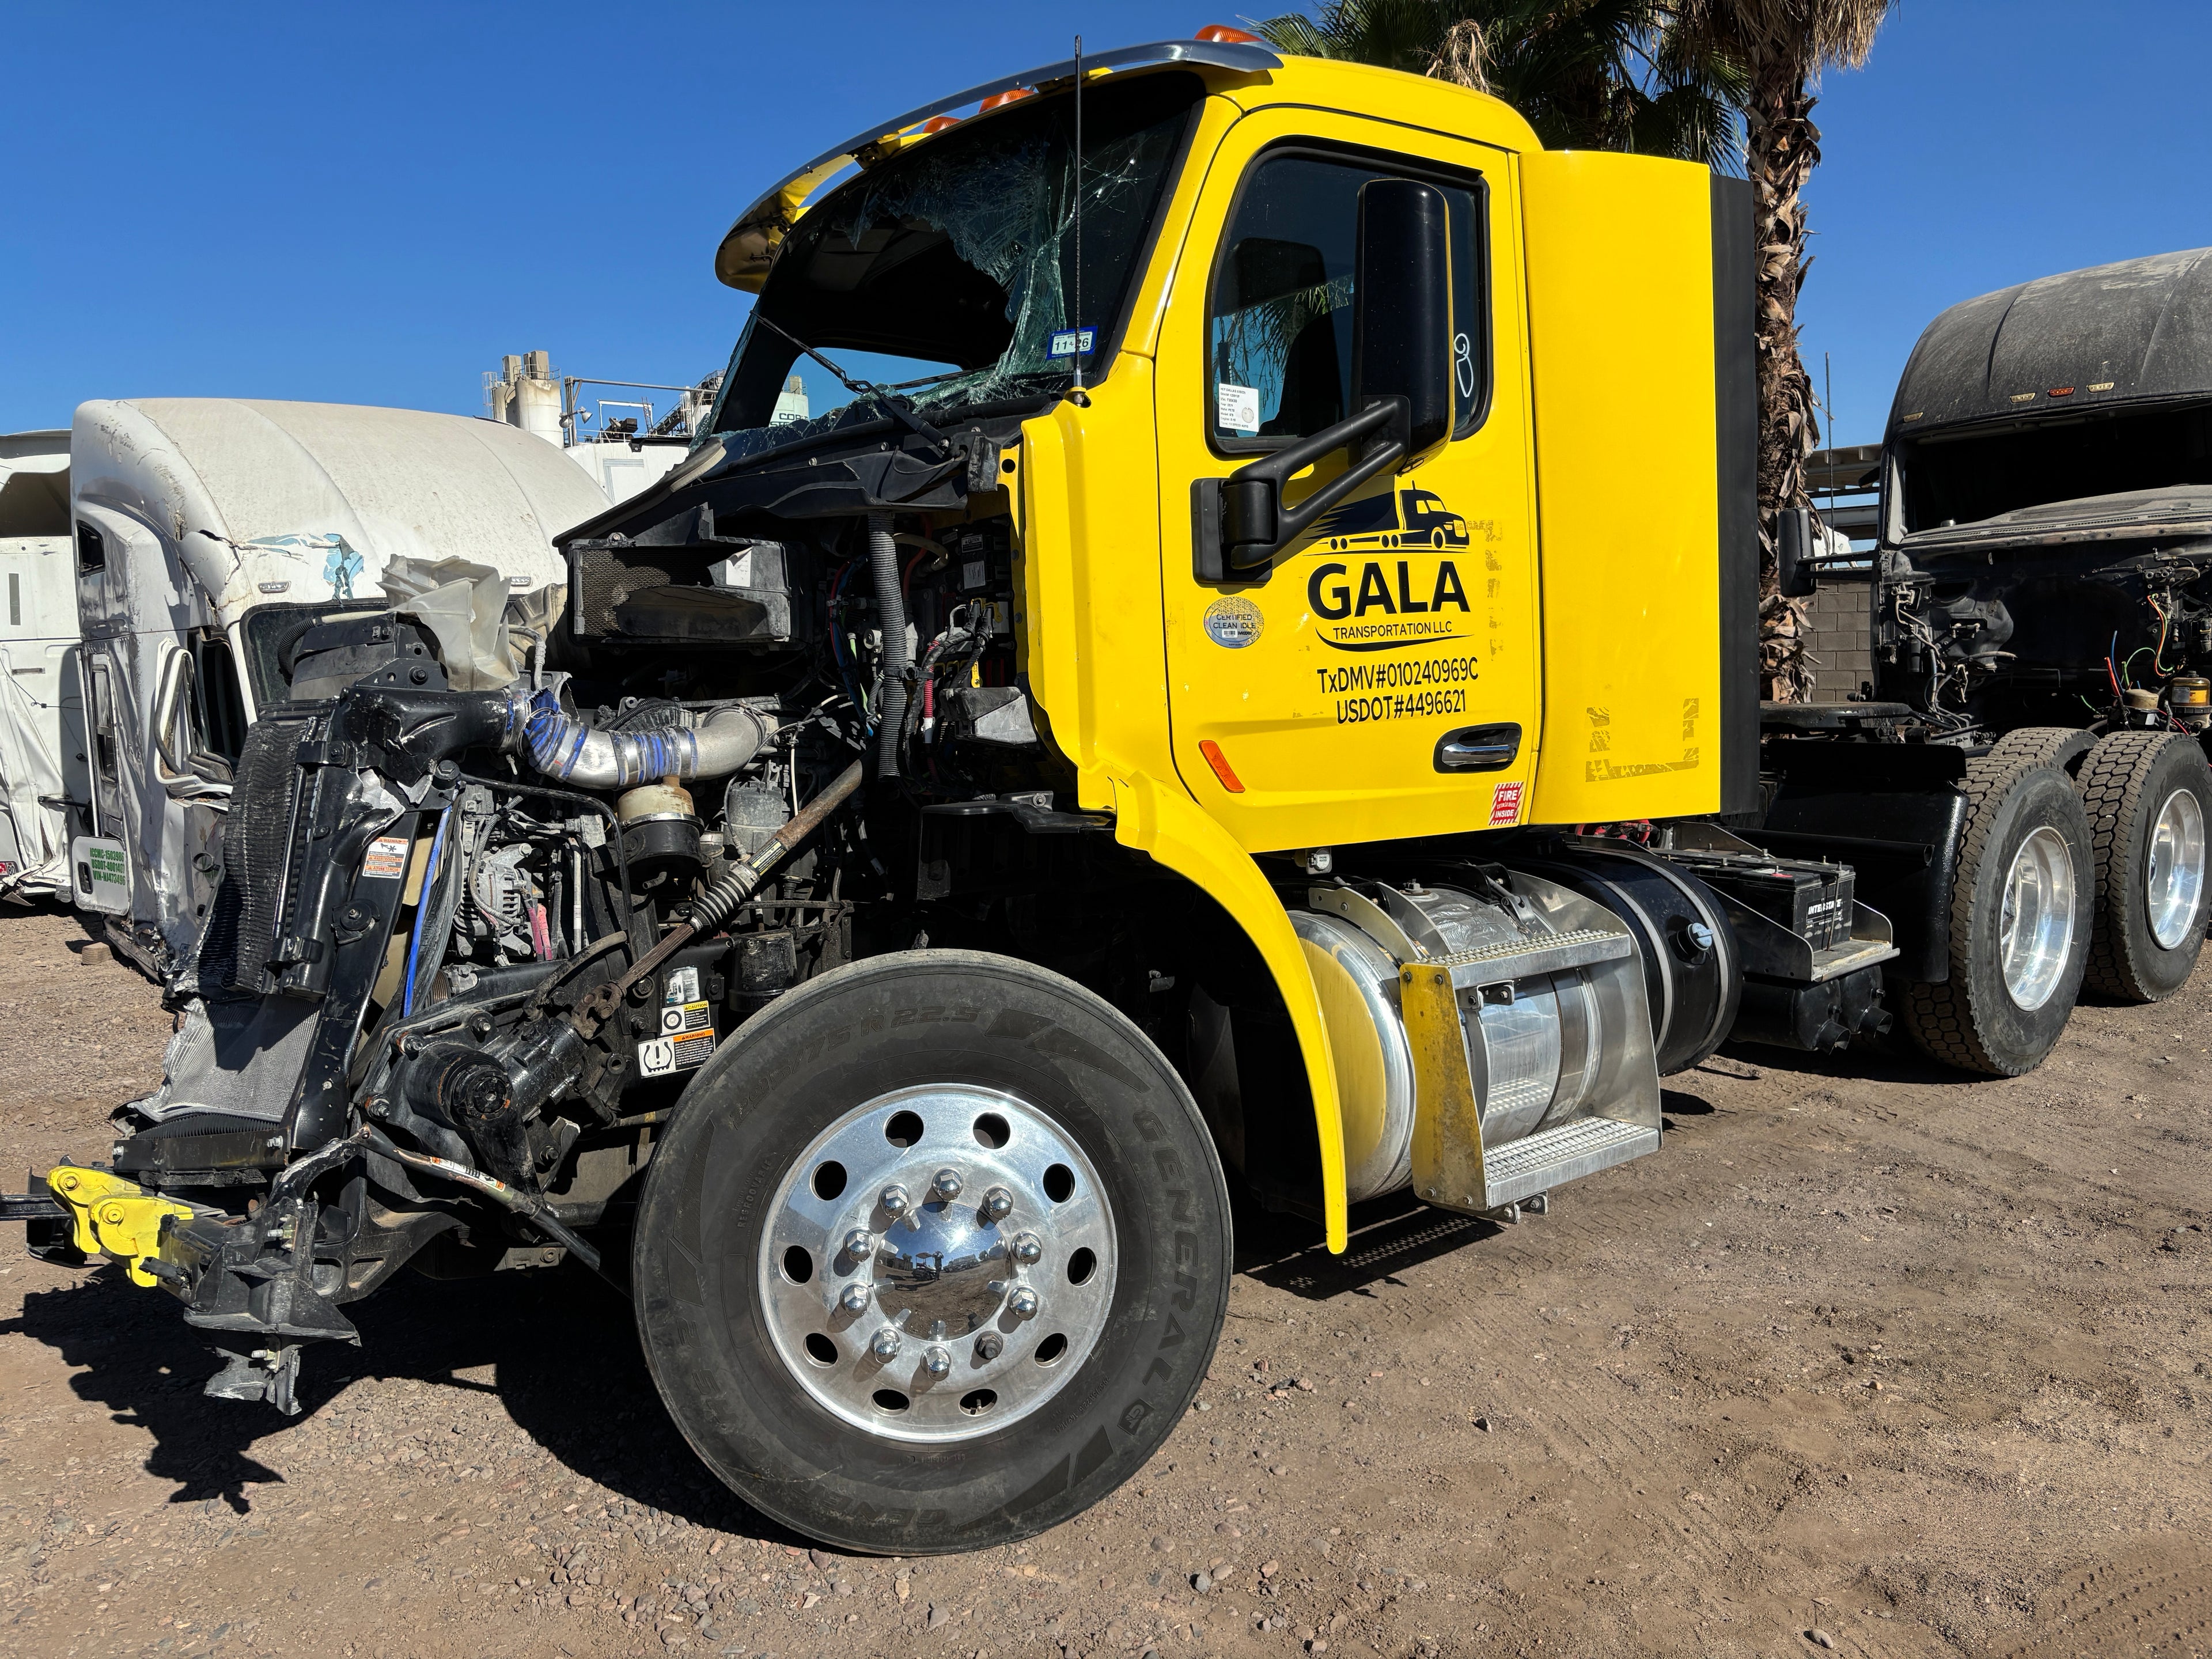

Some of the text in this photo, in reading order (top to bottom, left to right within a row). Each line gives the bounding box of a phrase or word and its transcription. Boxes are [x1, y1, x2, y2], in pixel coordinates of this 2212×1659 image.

[1055, 341, 1067, 351] 11
[1307, 560, 1471, 620] GALA
[1333, 620, 1452, 640] TRANSPORTATION LLC
[1317, 656, 1479, 694] TxDMV#010240969C
[1336, 688, 1466, 724] USDOT#4496621
[1498, 789, 1518, 802] FIRE
[1495, 809, 1514, 818] INSIDE
[1808, 899, 1842, 915] INTERSTAE
[737, 1159, 772, 1228] REGROOVABLE
[1132, 1109, 1199, 1385] GENERAL
